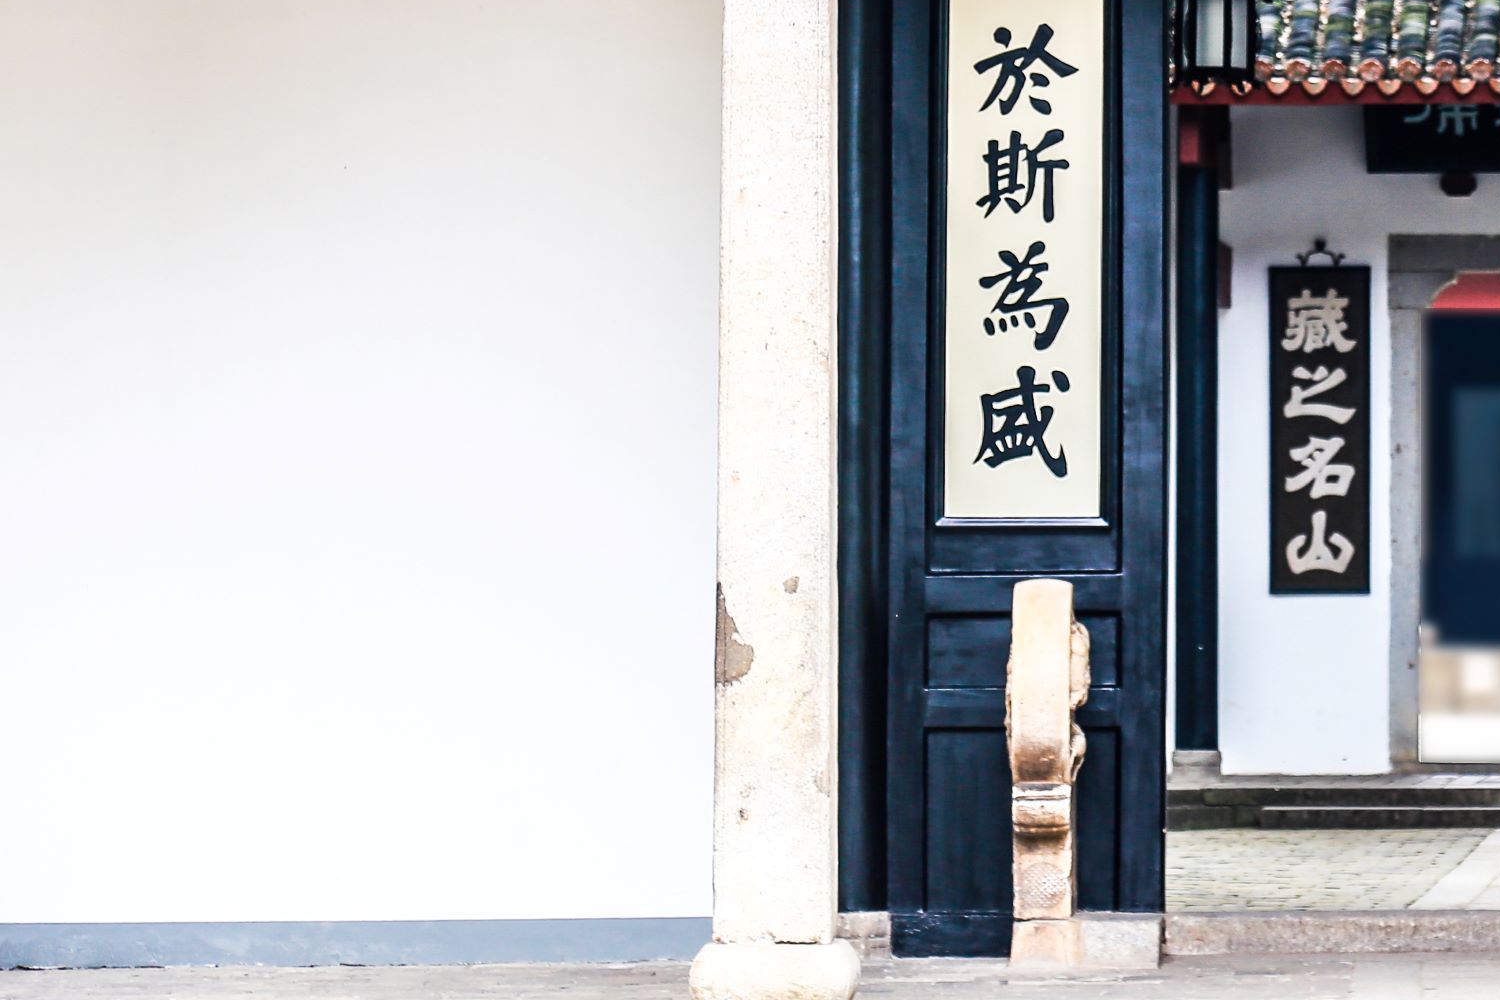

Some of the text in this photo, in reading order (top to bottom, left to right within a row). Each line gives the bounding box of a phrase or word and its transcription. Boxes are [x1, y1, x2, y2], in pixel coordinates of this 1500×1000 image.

[973, 23, 1080, 478] 於斯為盛
[1281, 288, 1358, 576] 藏之名山
